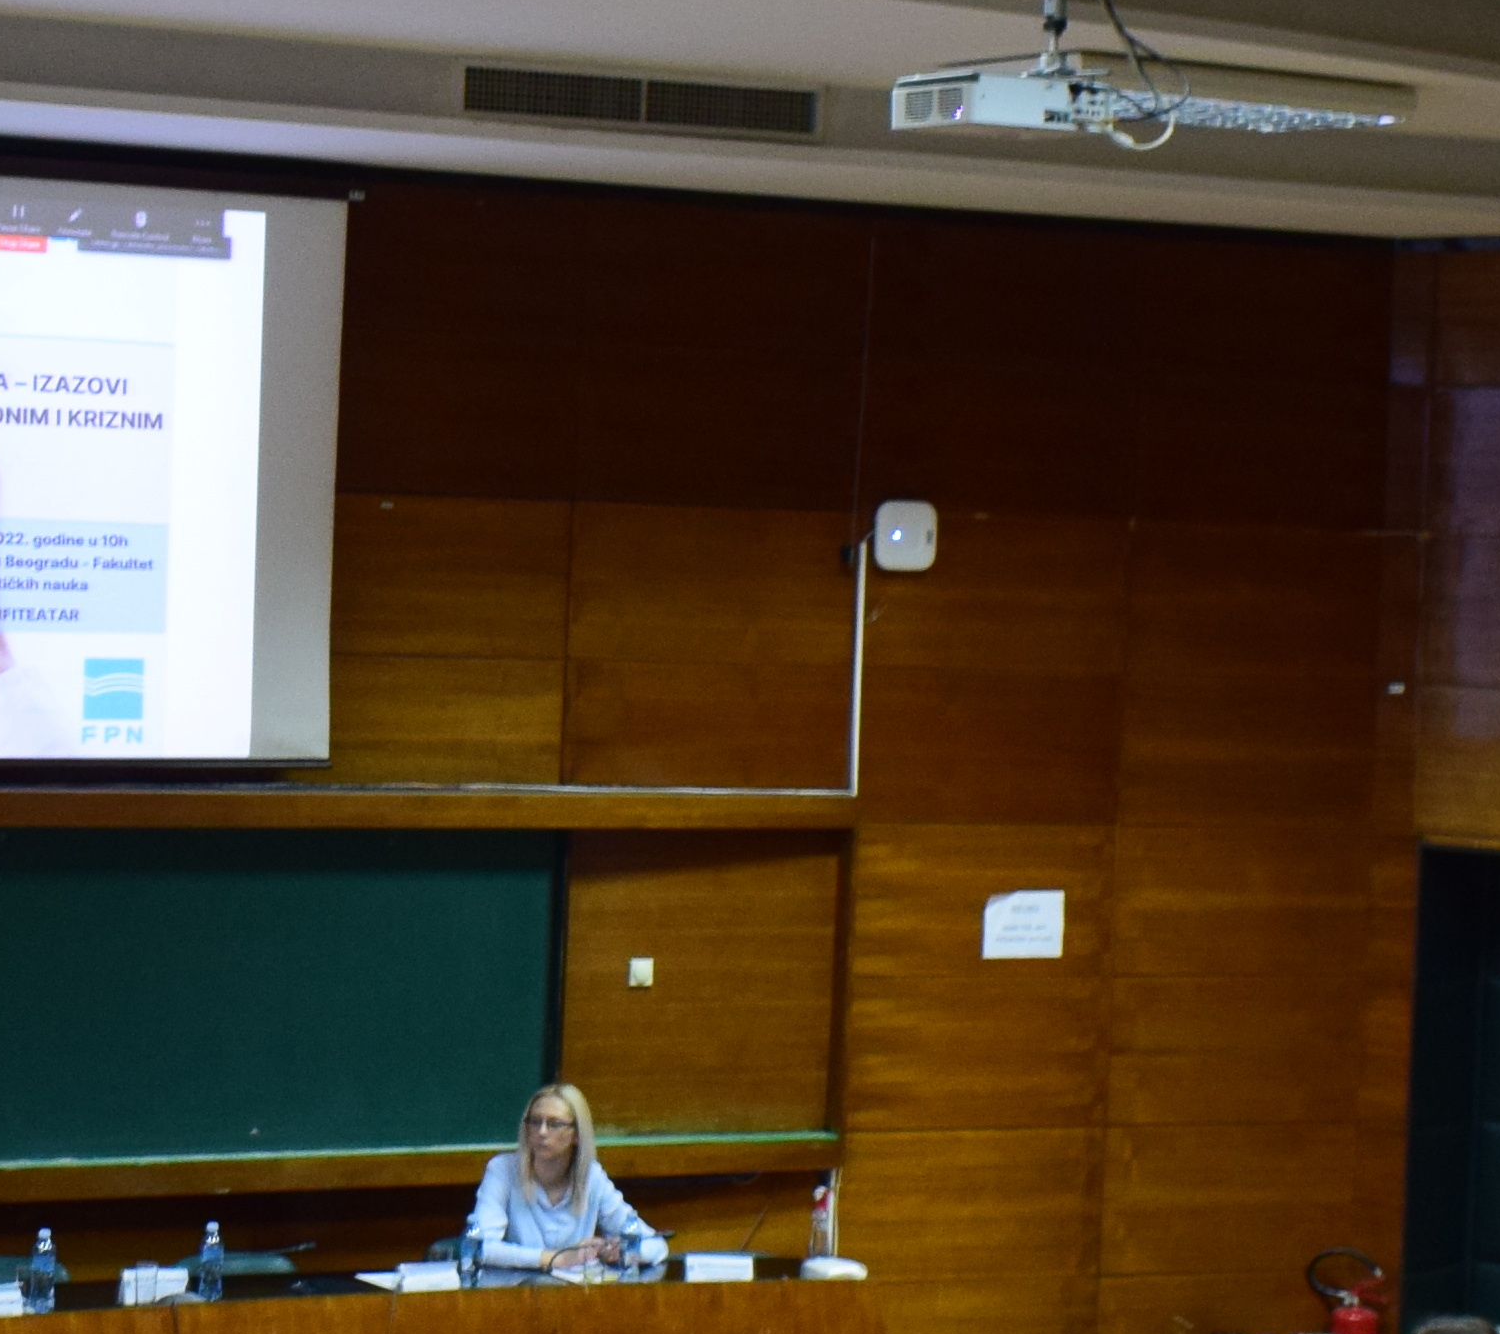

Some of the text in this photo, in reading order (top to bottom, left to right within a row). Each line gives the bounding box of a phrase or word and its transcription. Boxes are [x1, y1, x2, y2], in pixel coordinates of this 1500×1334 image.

[32, 374, 128, 396] IZAZOVI
[55, 408, 62, 427] I
[67, 409, 164, 430] KRIZNIM
[33, 532, 84, 549] godine
[88, 536, 98, 547] u
[101, 534, 129, 547] 10h
[5, 554, 79, 571] Beogradu
[92, 557, 154, 571] Fakultet
[42, 579, 89, 592] nauka
[81, 725, 143, 744] FPN
